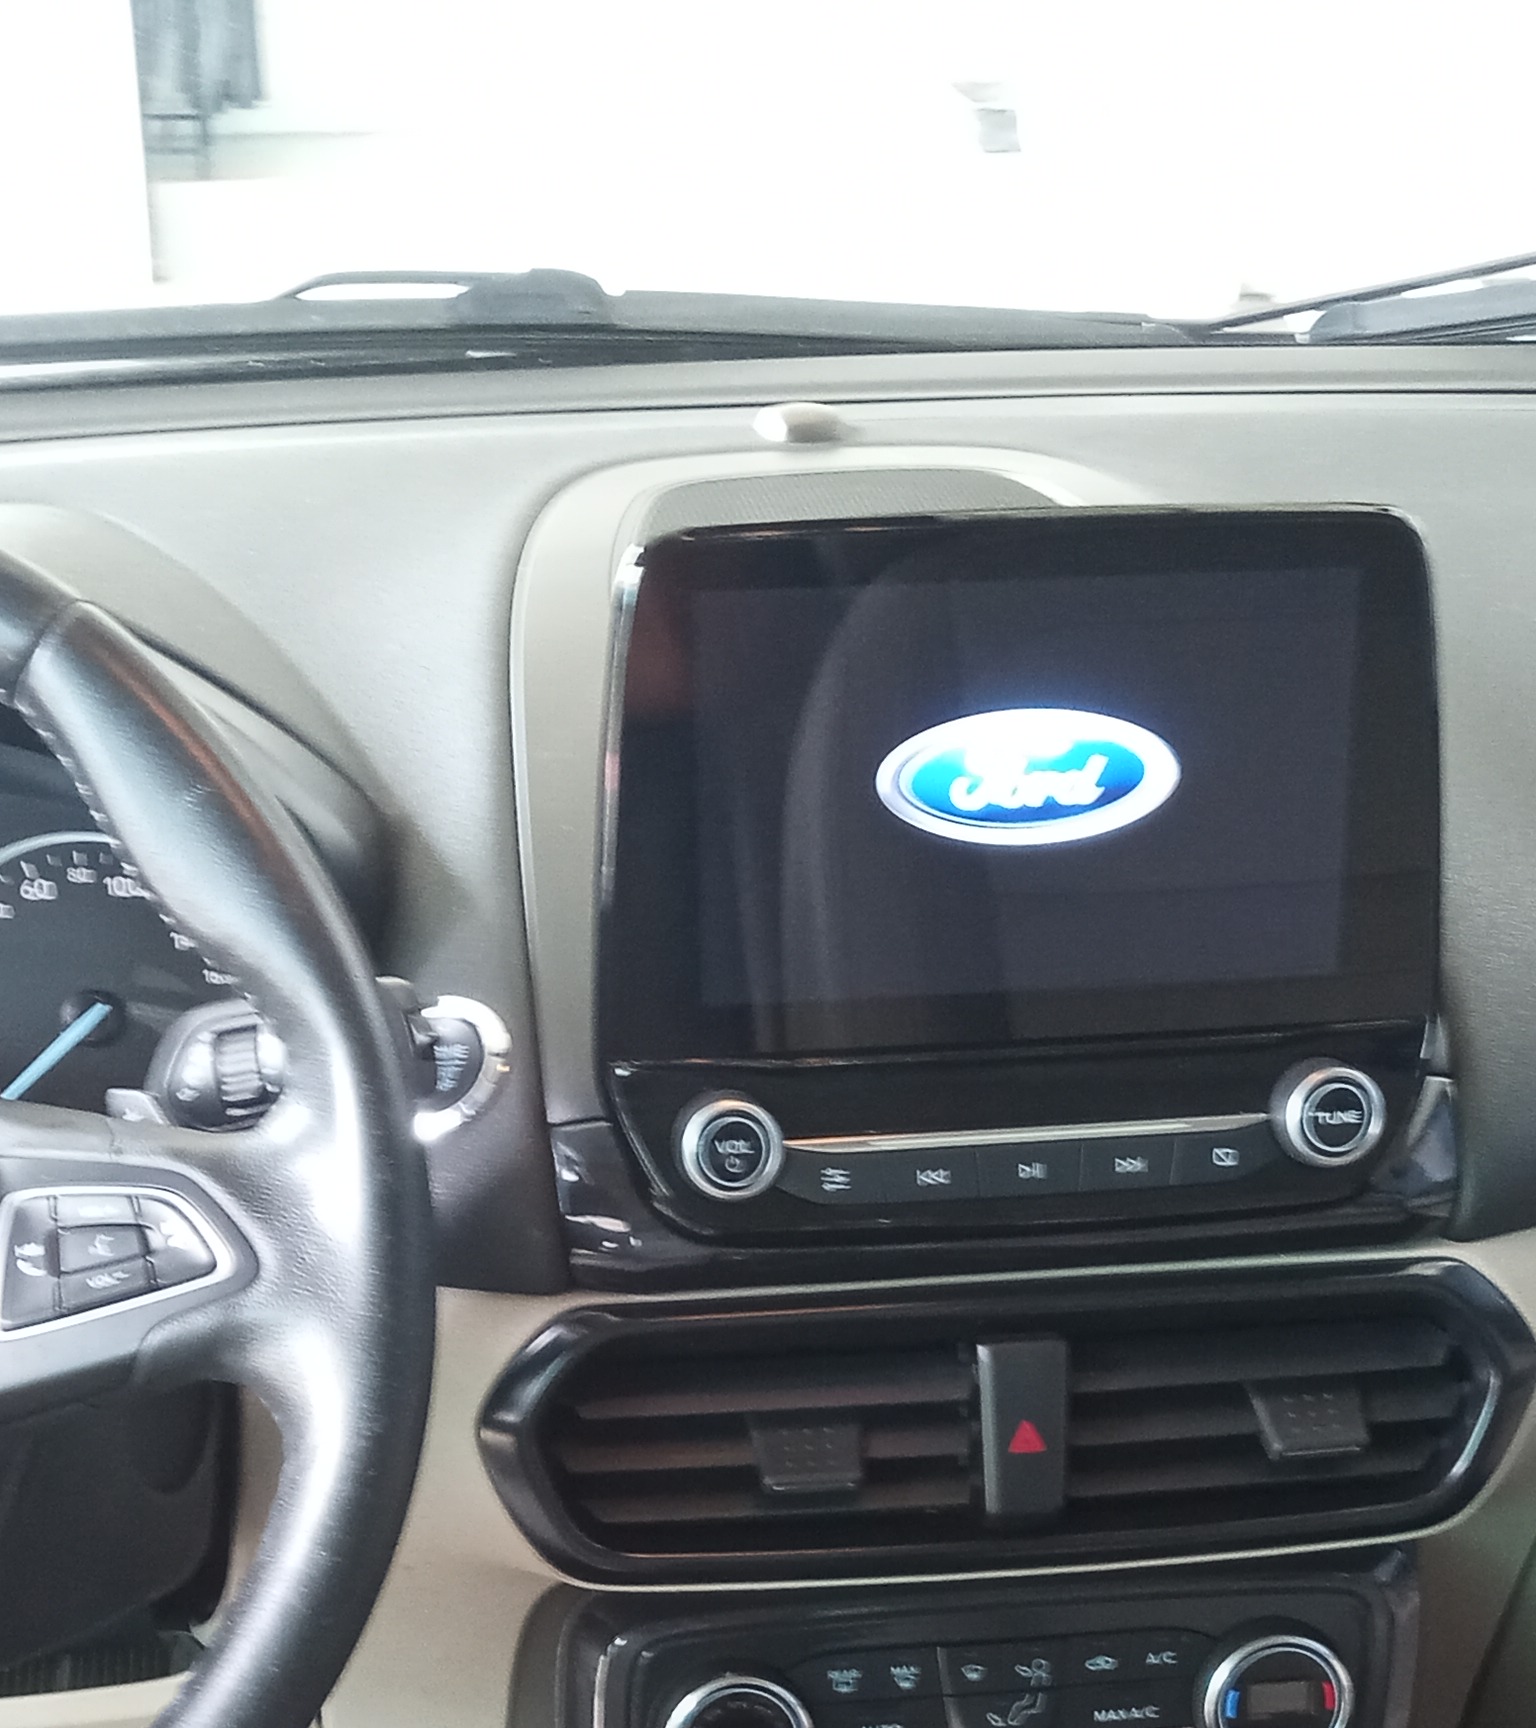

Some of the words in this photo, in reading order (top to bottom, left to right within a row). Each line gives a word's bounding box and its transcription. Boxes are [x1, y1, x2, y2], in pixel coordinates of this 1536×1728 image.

[19, 878, 59, 901] 60
[1314, 1108, 1363, 1125] TUNE
[713, 1139, 755, 1154] VOL
[1145, 1650, 1178, 1666] A/C
[1093, 1708, 1128, 1723] MAX
